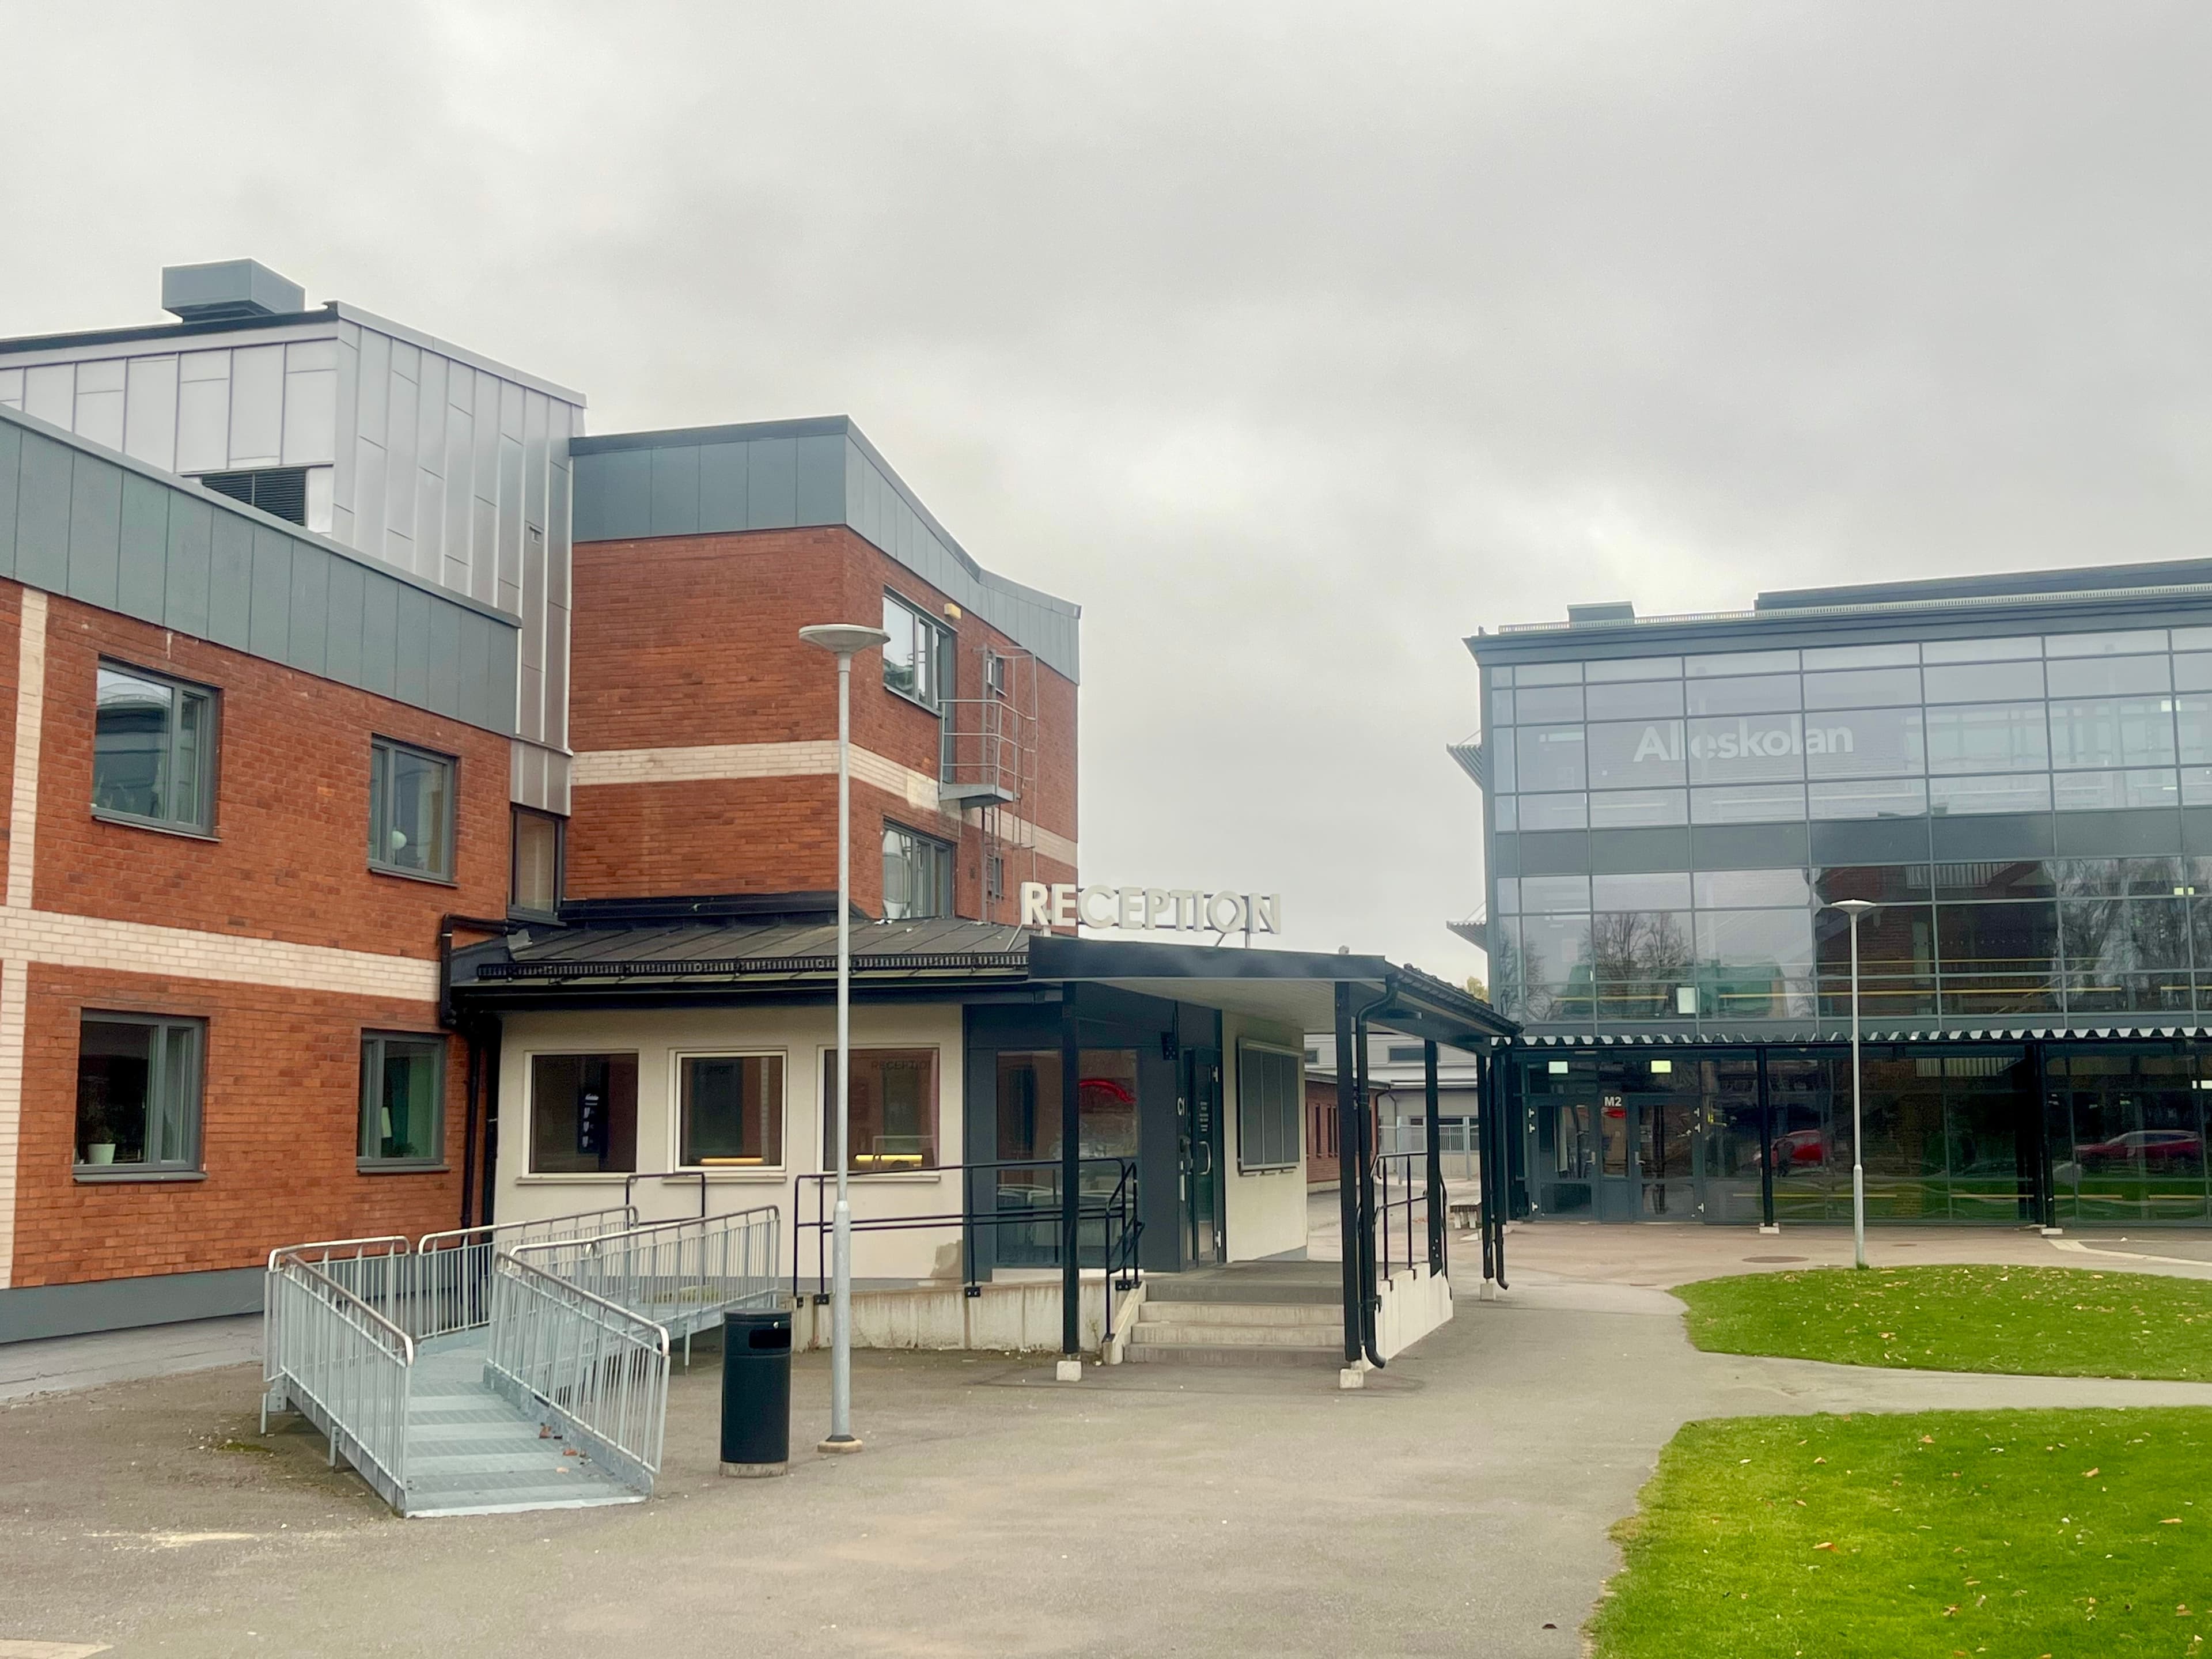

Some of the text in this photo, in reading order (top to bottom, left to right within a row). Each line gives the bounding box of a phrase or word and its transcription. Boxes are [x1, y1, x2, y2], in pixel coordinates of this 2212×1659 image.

[1633, 718, 1854, 762] Alleskolan
[1021, 882, 1281, 934] RECEPTION
[1604, 1097, 1622, 1107] M2
